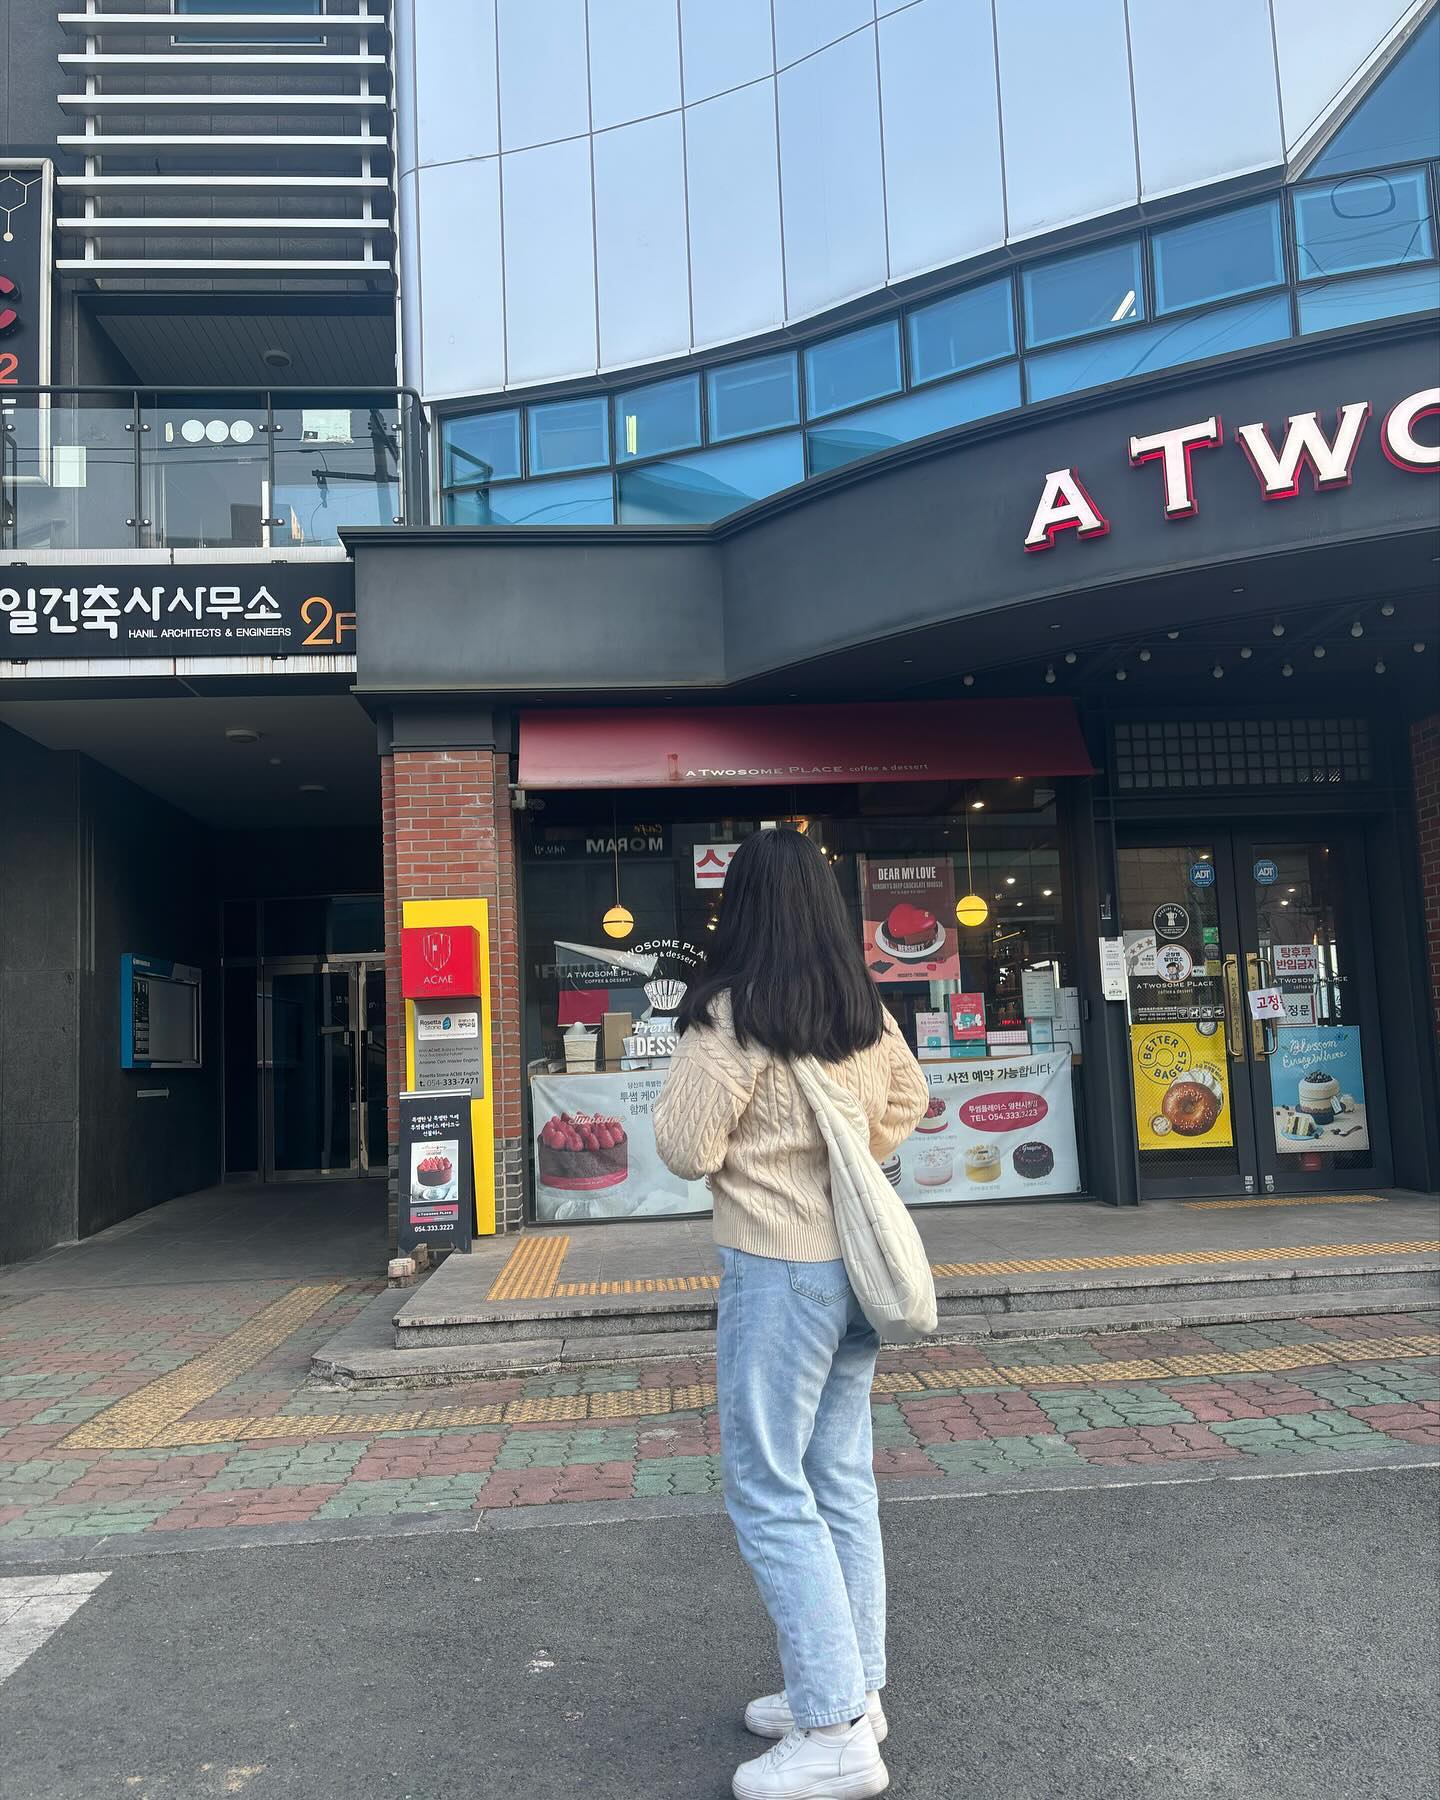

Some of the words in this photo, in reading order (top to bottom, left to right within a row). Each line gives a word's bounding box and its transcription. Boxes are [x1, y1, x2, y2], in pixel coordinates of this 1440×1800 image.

[1024, 466, 1110, 552] A
[0, 584, 283, 639] 일건축사사무소
[299, 595, 357, 647] 2F
[128, 628, 158, 639] HANIL
[160, 628, 222, 638] ARCHITECTS
[224, 628, 233, 638] &
[236, 627, 292, 638] ENGINEERS
[698, 767, 784, 776] TWOSOME
[789, 766, 844, 774] PLACE
[890, 763, 929, 771] dessert
[696, 848, 736, 878] 스
[878, 867, 900, 880] DEAR
[902, 866, 915, 880] MY
[916, 866, 937, 880] LOVE
[1194, 870, 1210, 880] ADT
[1258, 868, 1274, 877] ADT
[1280, 946, 1312, 958] 탕후루
[666, 950, 698, 968] dessert
[1276, 958, 1317, 970] 반입금지
[424, 974, 454, 985] ACME
[1256, 994, 1280, 1010] 고정
[1288, 1004, 1310, 1017] 정문
[1143, 1035, 1179, 1060] BETTER
[1154, 1050, 1187, 1080] BAGELS
[946, 1072, 968, 1085] 사전
[972, 1069, 994, 1082] 예약
[998, 1063, 1054, 1080] 가능합니다.
[426, 1077, 479, 1087] 054-333-7471
[620, 1091, 638, 1102] 투썸
[640, 1090, 660, 1101] 케이
[630, 1104, 648, 1116] 함께
[968, 1104, 1007, 1113] 투썸플레이스
[970, 1114, 986, 1122] TEL
[988, 1109, 1038, 1120] 054.333.3223
[414, 1224, 454, 1232] 054.333.3223
